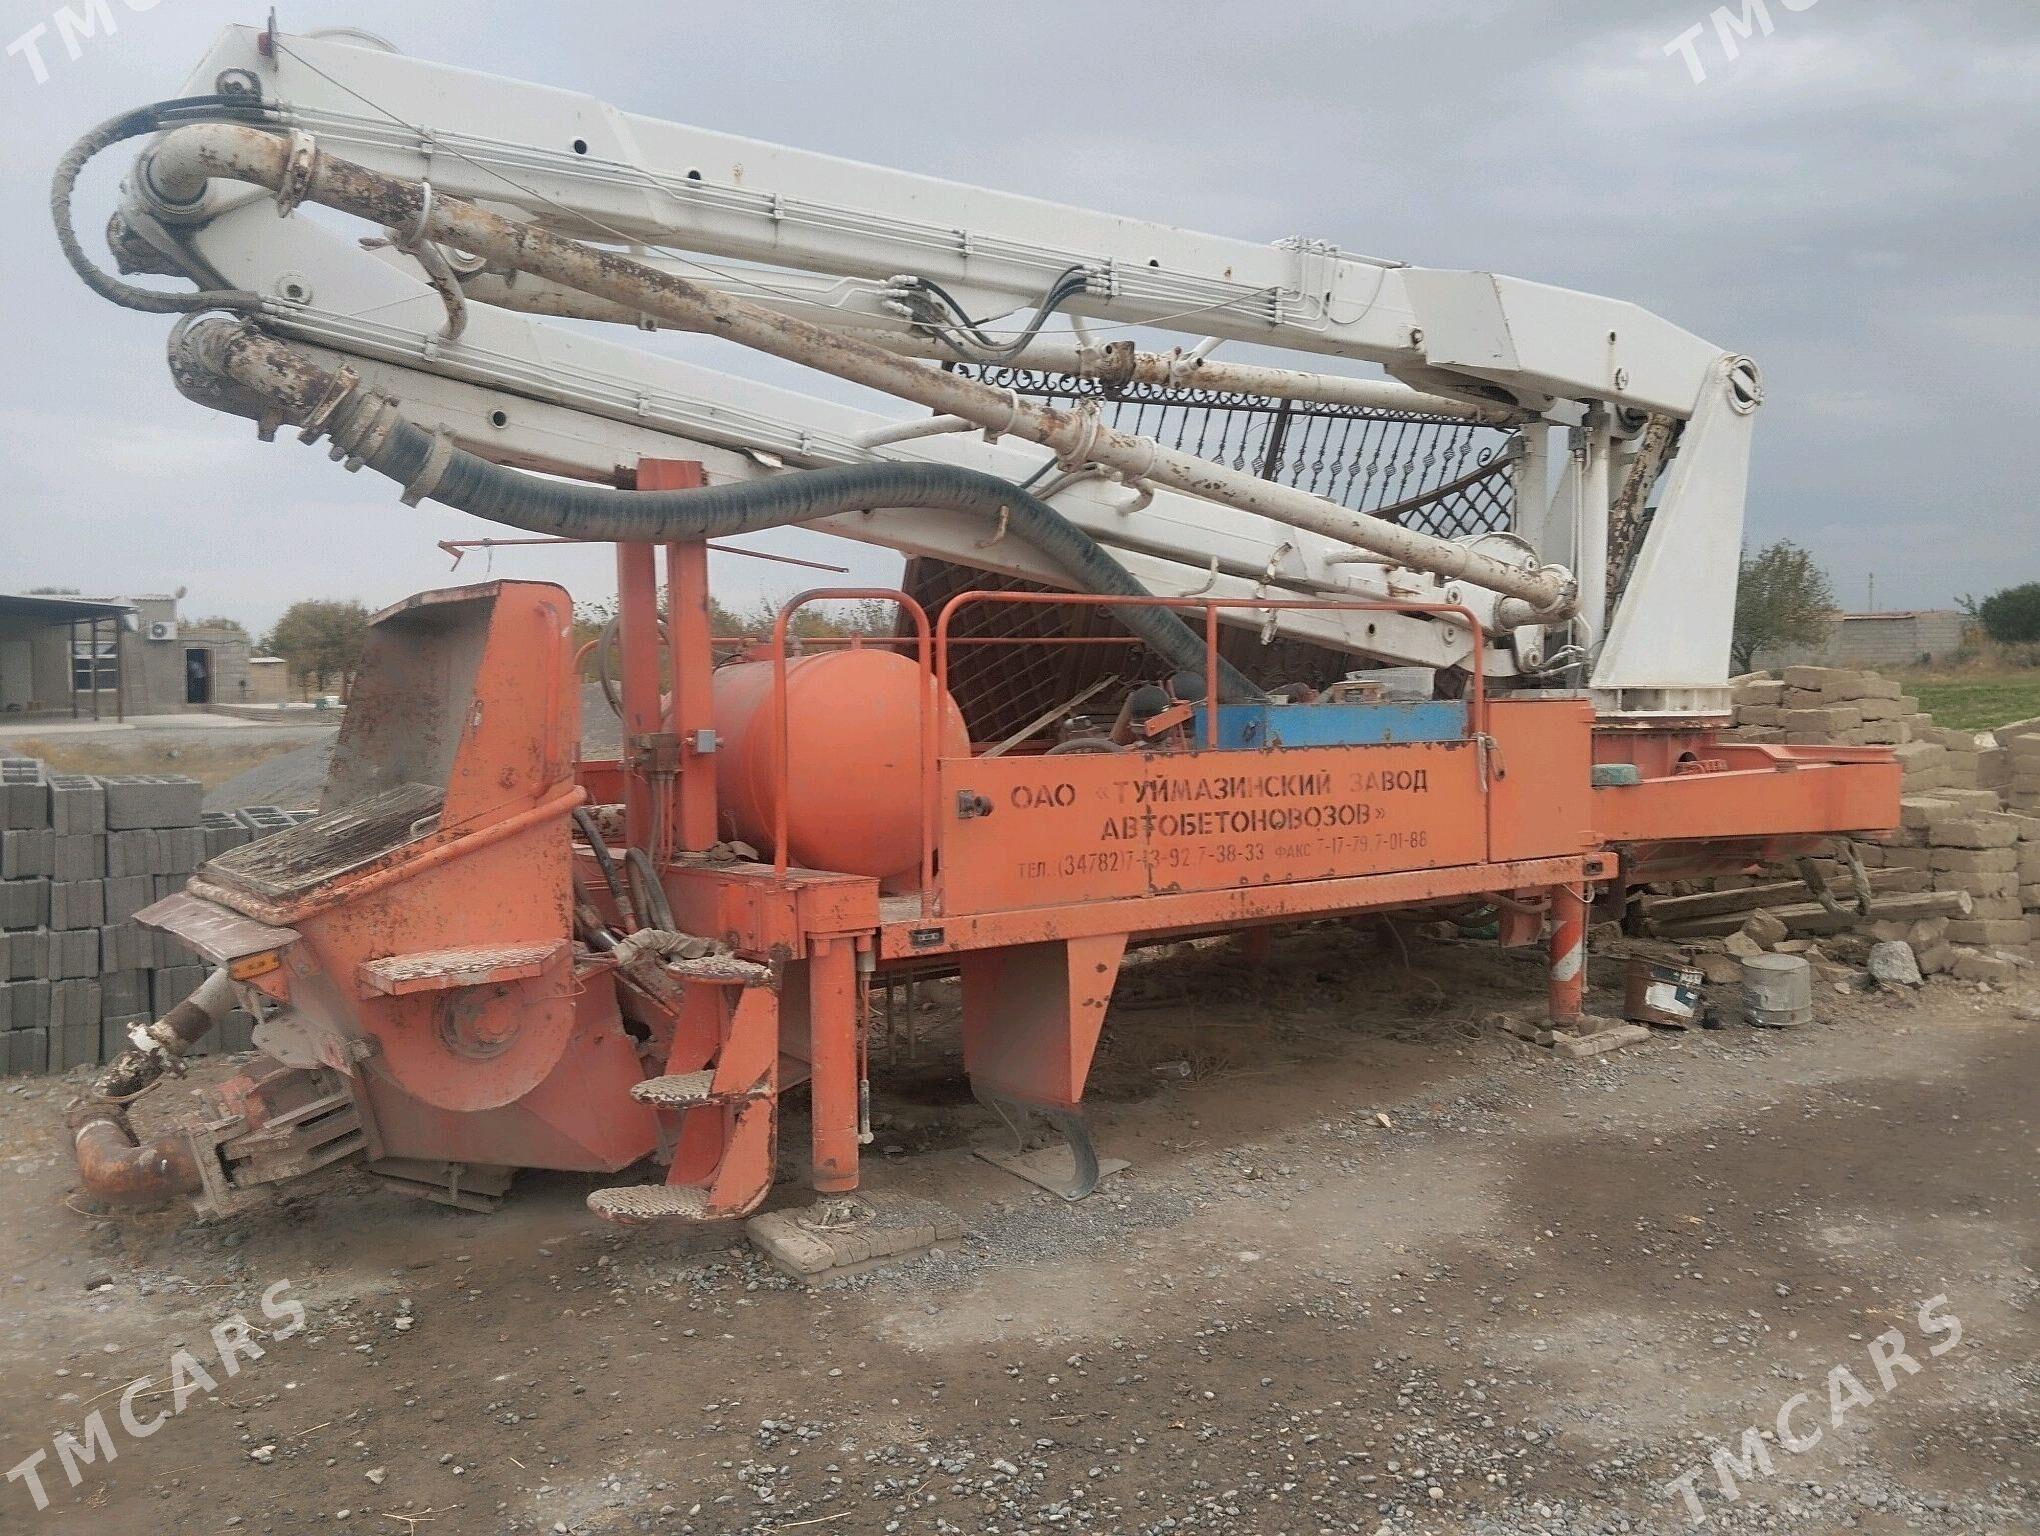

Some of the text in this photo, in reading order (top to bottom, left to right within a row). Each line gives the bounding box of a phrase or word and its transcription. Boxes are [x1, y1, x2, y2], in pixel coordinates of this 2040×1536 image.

[1010, 783, 1076, 809] ОАО
[1350, 769, 1428, 793] ЗАВОД
[1274, 842, 1311, 858] ФАКС
